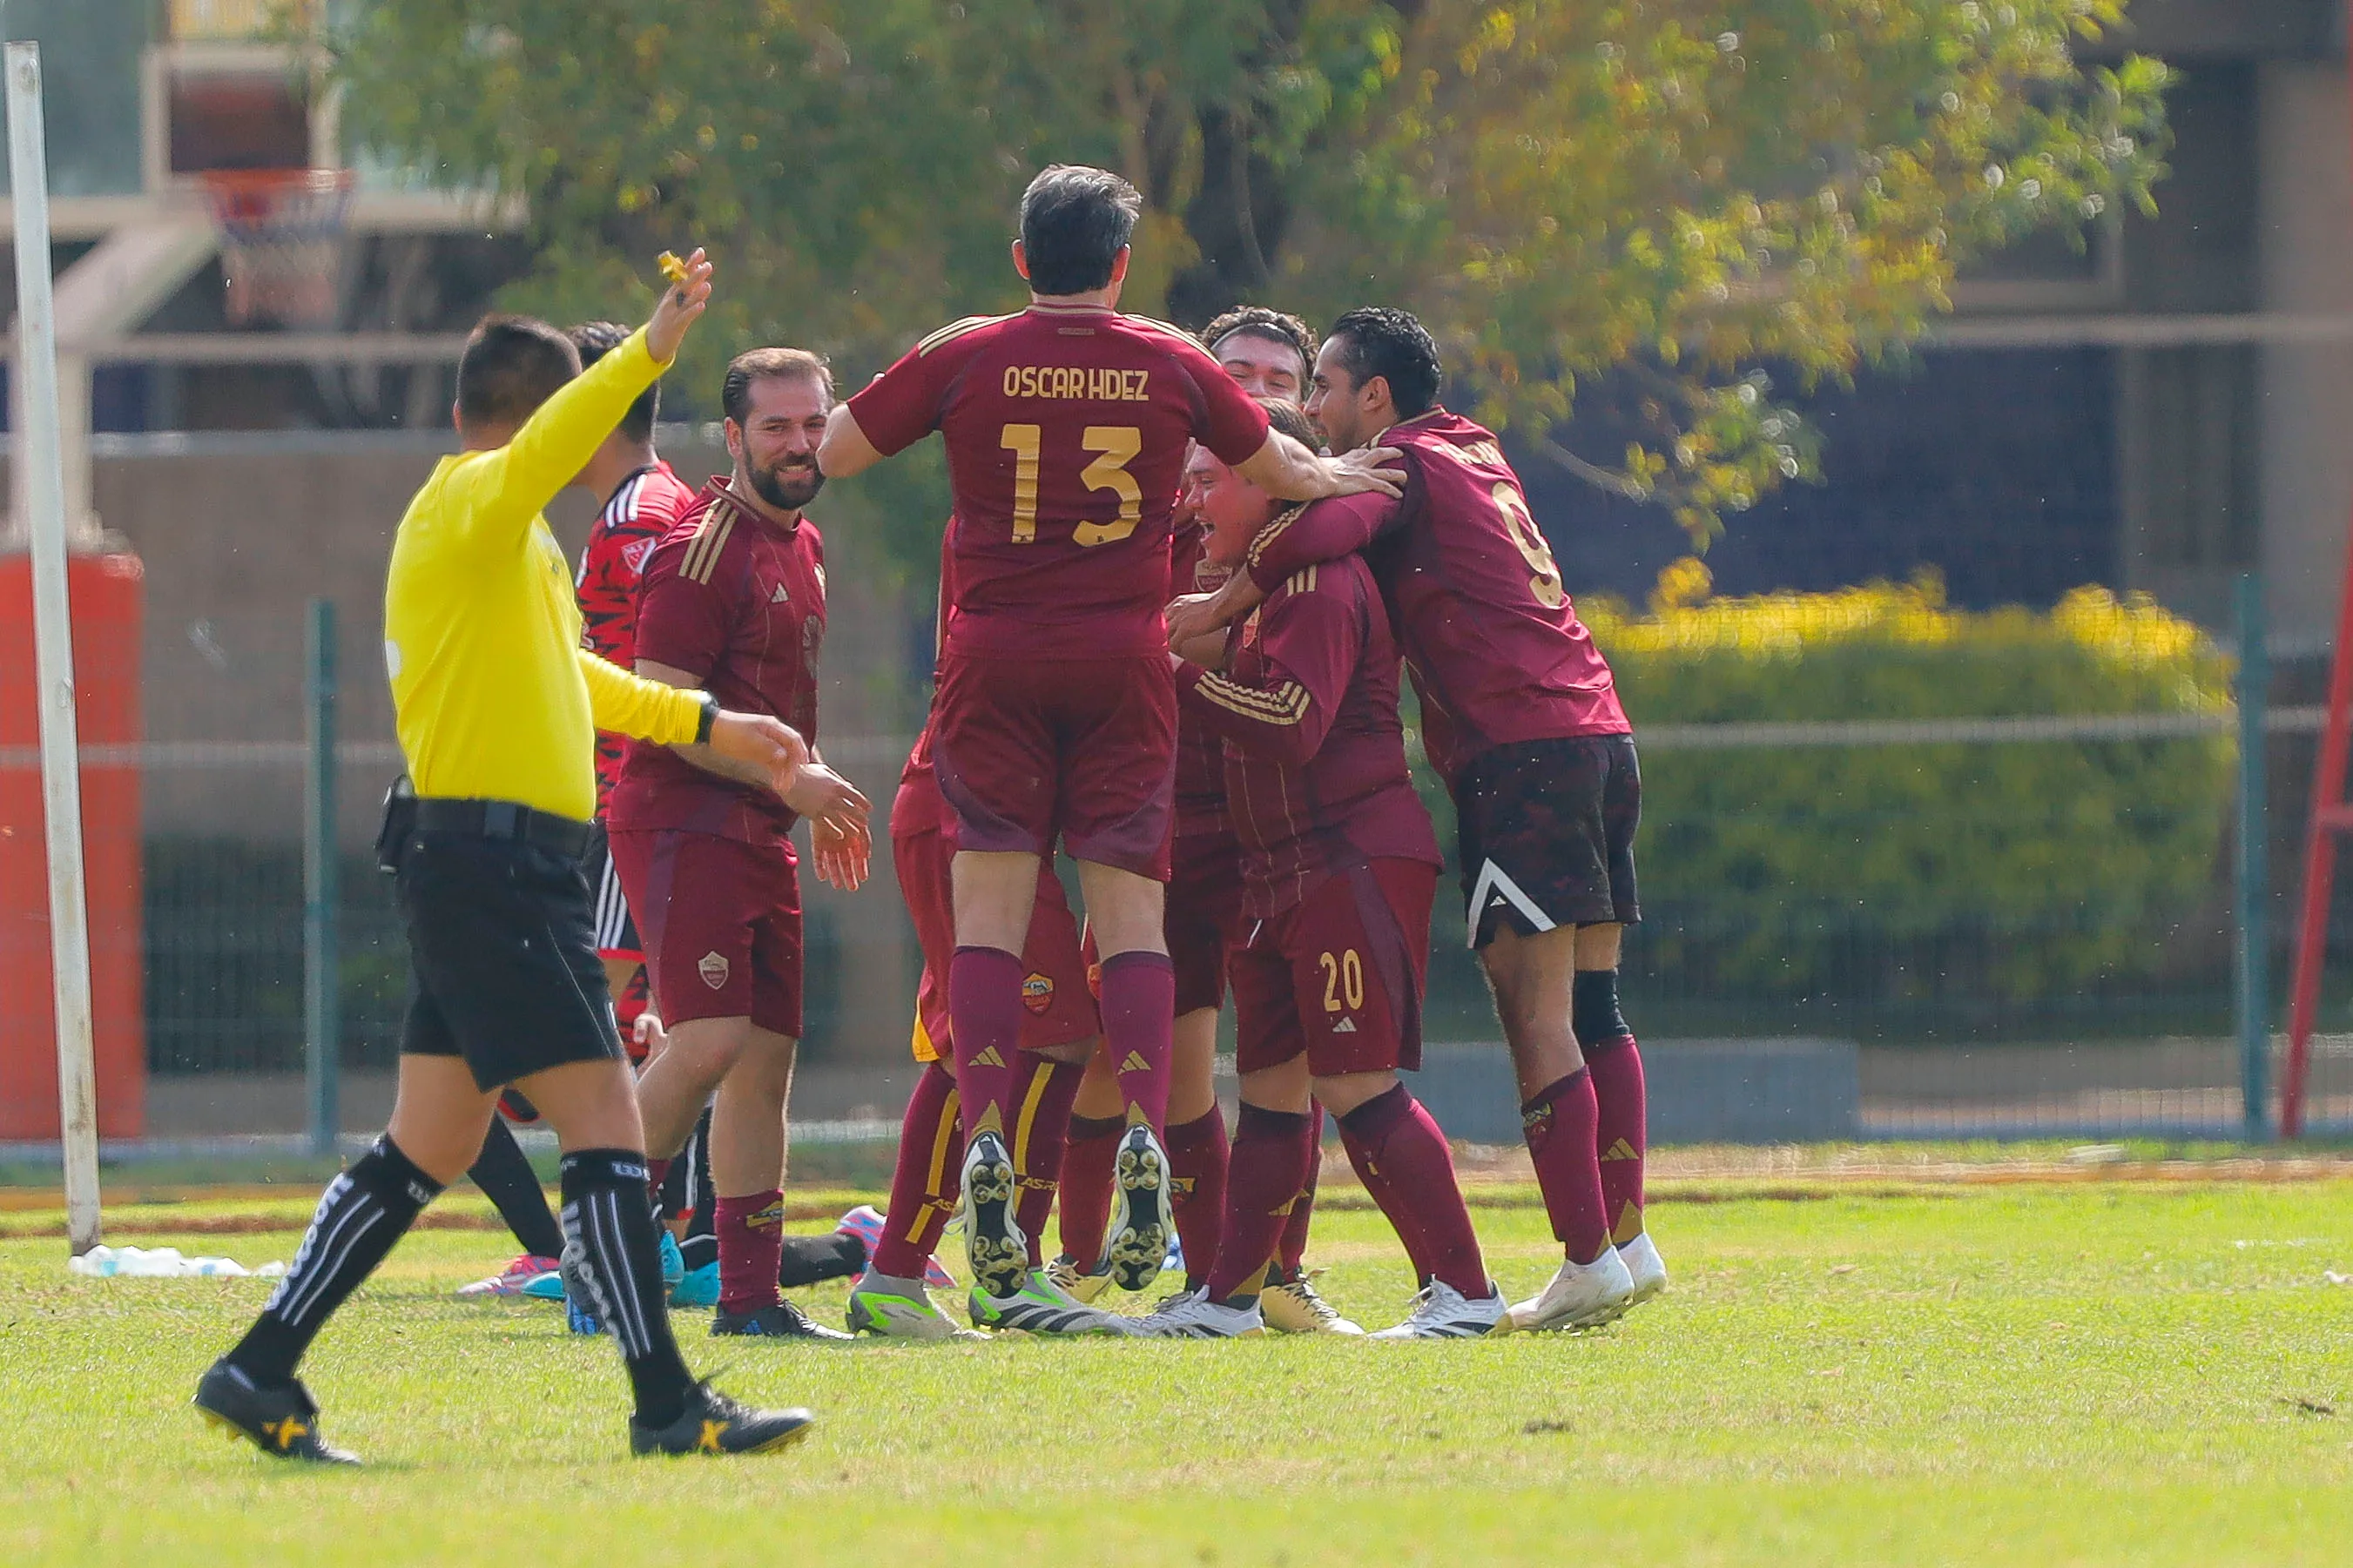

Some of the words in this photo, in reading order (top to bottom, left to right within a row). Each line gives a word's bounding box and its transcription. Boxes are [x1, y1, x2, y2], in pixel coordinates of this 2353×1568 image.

[1003, 366, 1086, 400] OSCAR
[1088, 368, 1150, 401] HDEZ
[1001, 423, 1143, 547] 13
[1492, 481, 1562, 609] 9
[1319, 948, 1364, 1012] 20
